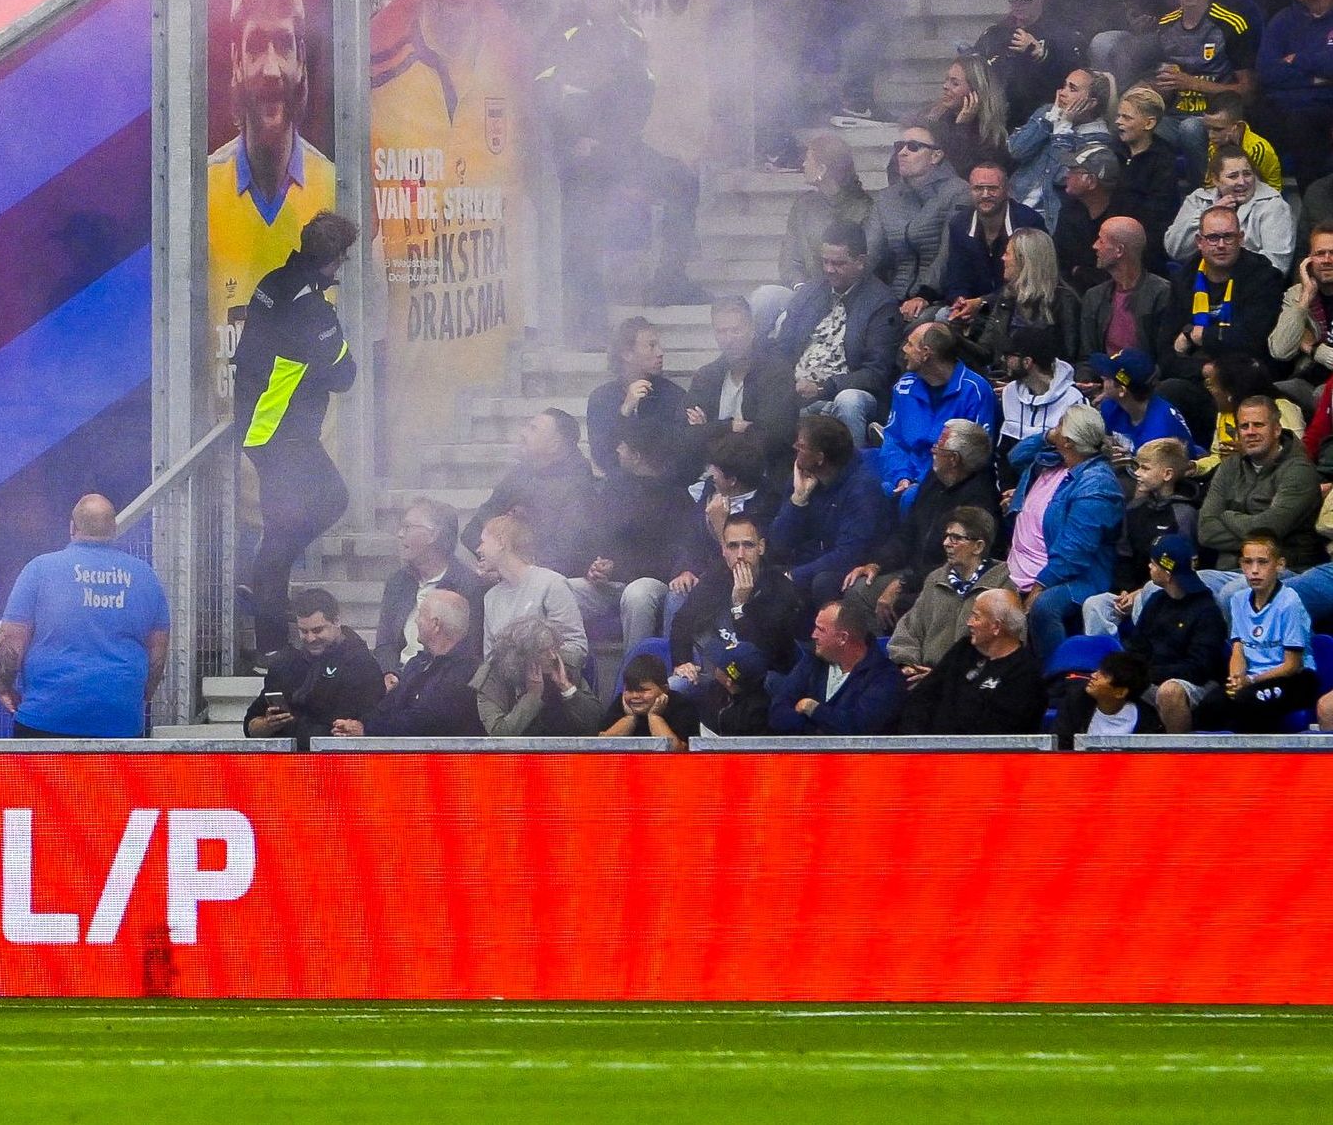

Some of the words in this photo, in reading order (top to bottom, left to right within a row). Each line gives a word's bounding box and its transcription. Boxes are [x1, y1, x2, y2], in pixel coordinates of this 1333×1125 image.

[374, 147, 444, 181] SANDER
[374, 186, 411, 219] VAN
[417, 186, 438, 219] DE
[407, 281, 506, 341] DRAISMA
[73, 564, 131, 588] Security
[83, 588, 124, 608] Noord
